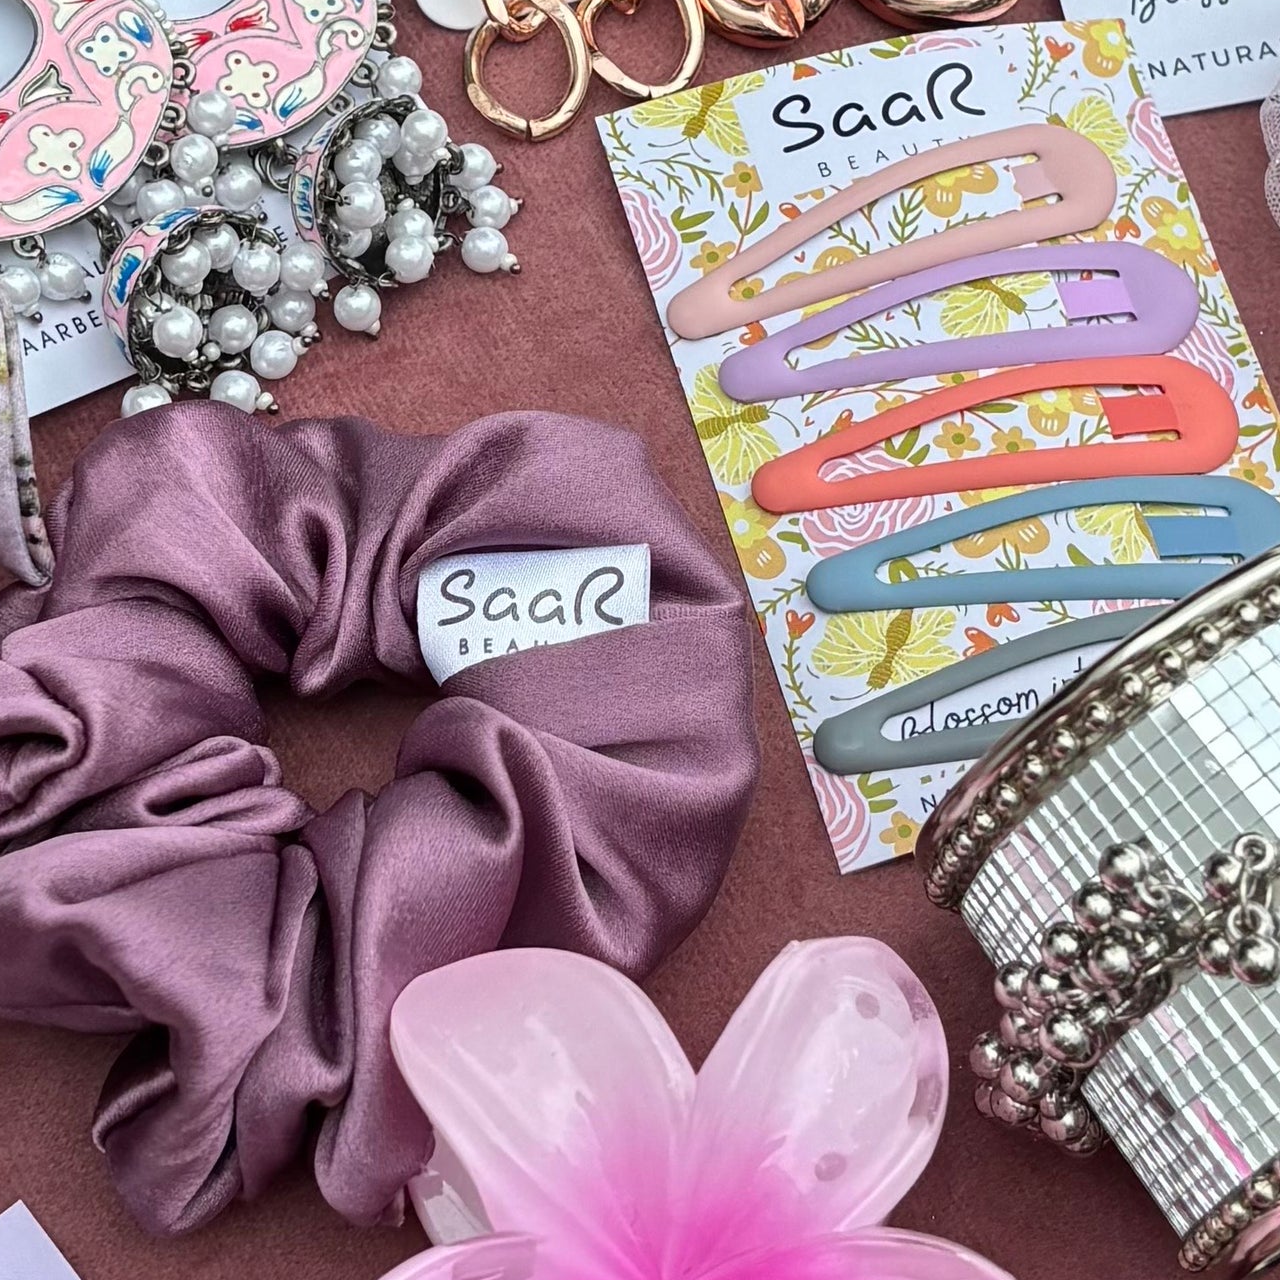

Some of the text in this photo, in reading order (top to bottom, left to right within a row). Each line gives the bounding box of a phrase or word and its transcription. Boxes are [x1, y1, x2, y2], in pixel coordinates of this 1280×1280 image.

[771, 61, 987, 154] SaaR
[816, 135, 971, 179] BEAUT
[437, 566, 626, 627] SaaR
